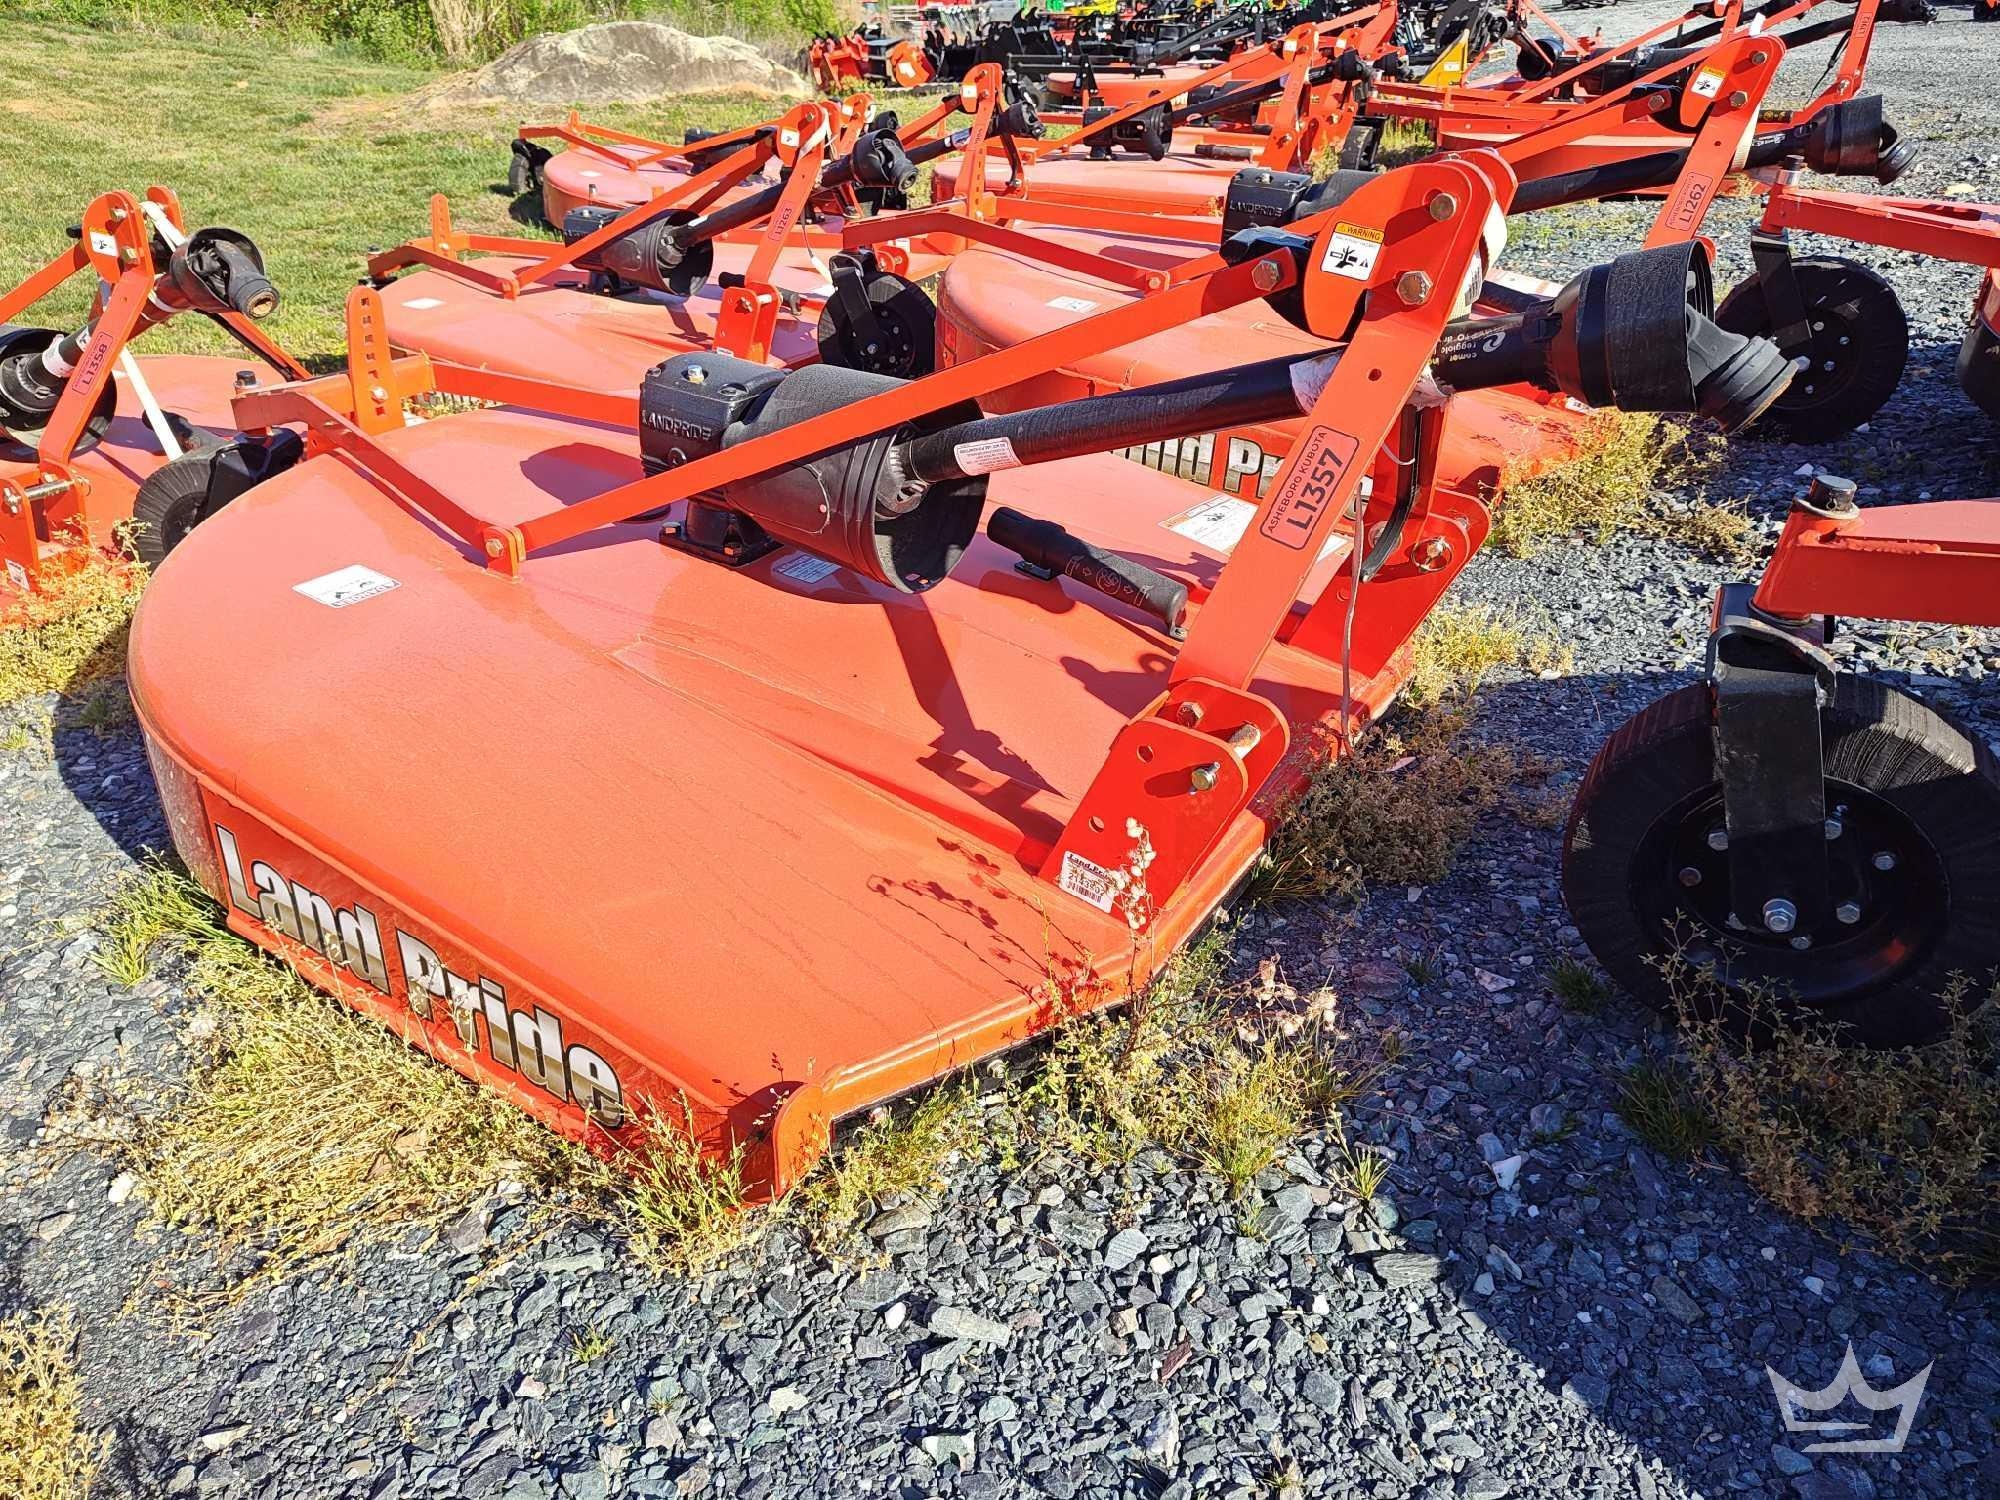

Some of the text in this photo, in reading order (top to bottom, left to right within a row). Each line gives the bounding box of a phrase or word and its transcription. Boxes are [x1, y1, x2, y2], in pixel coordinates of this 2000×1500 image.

[774, 207, 793, 235] L1263
[1680, 184, 1707, 223] L1262
[1347, 226, 1382, 241] WARNING
[82, 343, 108, 385] L1358
[641, 409, 712, 441] LANDPRIDE
[1267, 431, 1328, 534] ASHEBORO KUBOTA
[1286, 447, 1344, 530] L1357
[214, 822, 625, 1130] Land Pride
